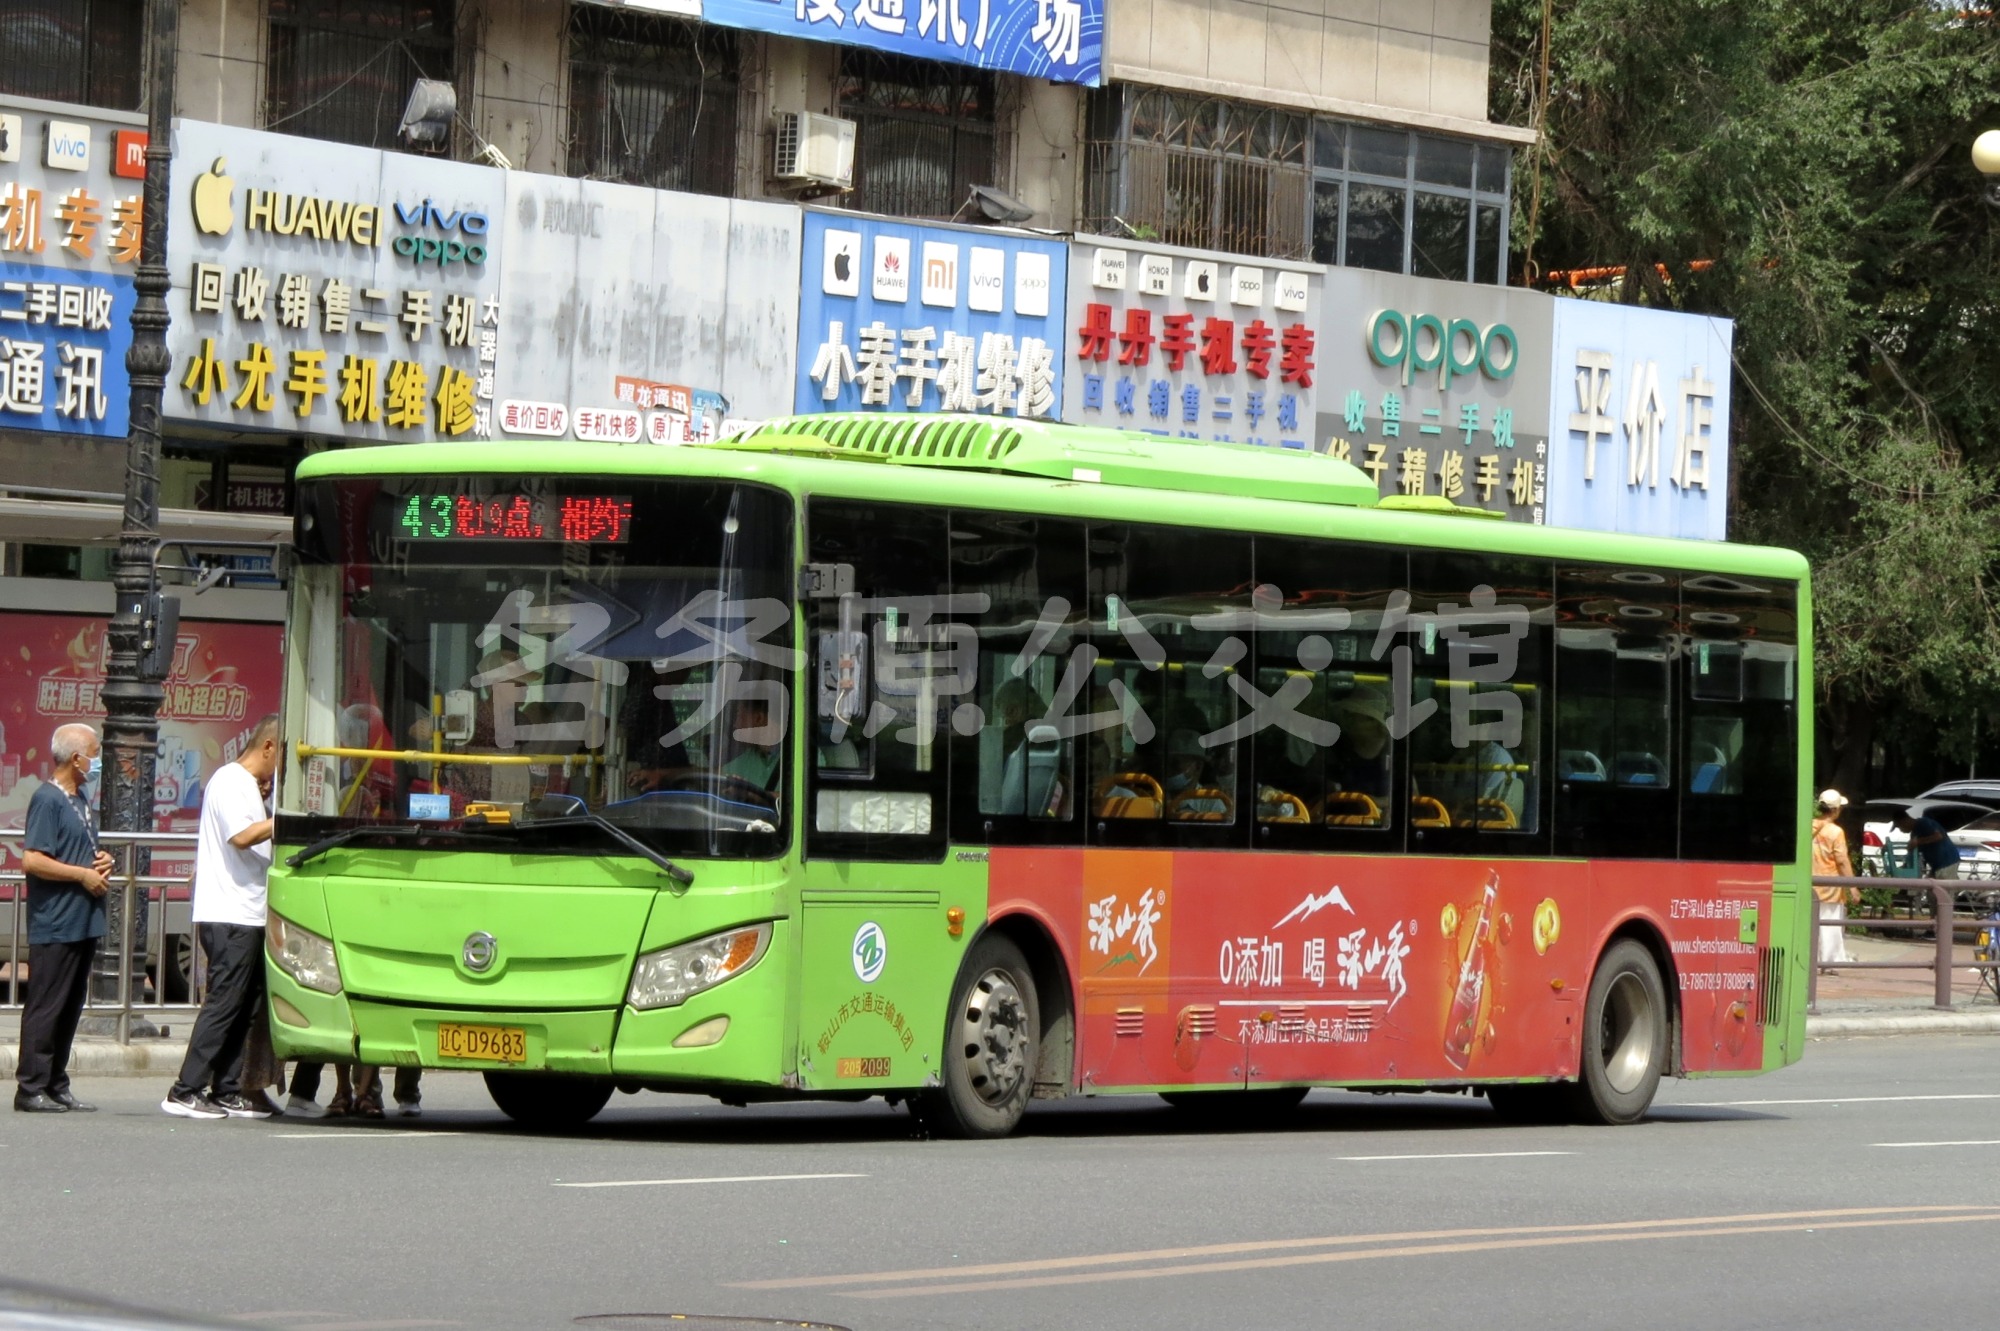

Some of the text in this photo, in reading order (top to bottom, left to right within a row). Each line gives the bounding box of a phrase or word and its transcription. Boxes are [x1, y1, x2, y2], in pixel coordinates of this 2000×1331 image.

[54, 133, 87, 158] vivo
[246, 187, 383, 247] HUAWEI
[394, 198, 489, 236] vivo
[393, 234, 488, 267] oppo
[1101, 258, 1126, 270] HUAWEI
[1147, 264, 1170, 276] HONOR
[193, 261, 478, 348] 回收销售二手机
[876, 276, 906, 289] HUAWEI
[973, 272, 1001, 288] vivo
[1239, 279, 1261, 292] oppo
[1283, 285, 1306, 300] vivo
[0, 281, 113, 330] 二手回收
[474, 293, 500, 437] 大器通讯
[810, 321, 1056, 417] 小春手机维修
[1078, 302, 1316, 389] 丹丹手机专卖
[1366, 308, 1519, 391] oppo
[0, 336, 108, 420] 通讯
[184, 337, 478, 436] 小尤手机维修
[1082, 372, 1298, 431] 回收销售二手机
[504, 404, 565, 432] 高价回收
[579, 412, 638, 443] 手机快修
[1344, 389, 1516, 449] 收售二手机
[1568, 349, 1716, 492] 平价店
[1533, 440, 1546, 526] 中光通信
[402, 495, 452, 537] 43
[1303, 937, 1326, 988] 喝
[861, 1057, 890, 1077] 2099
